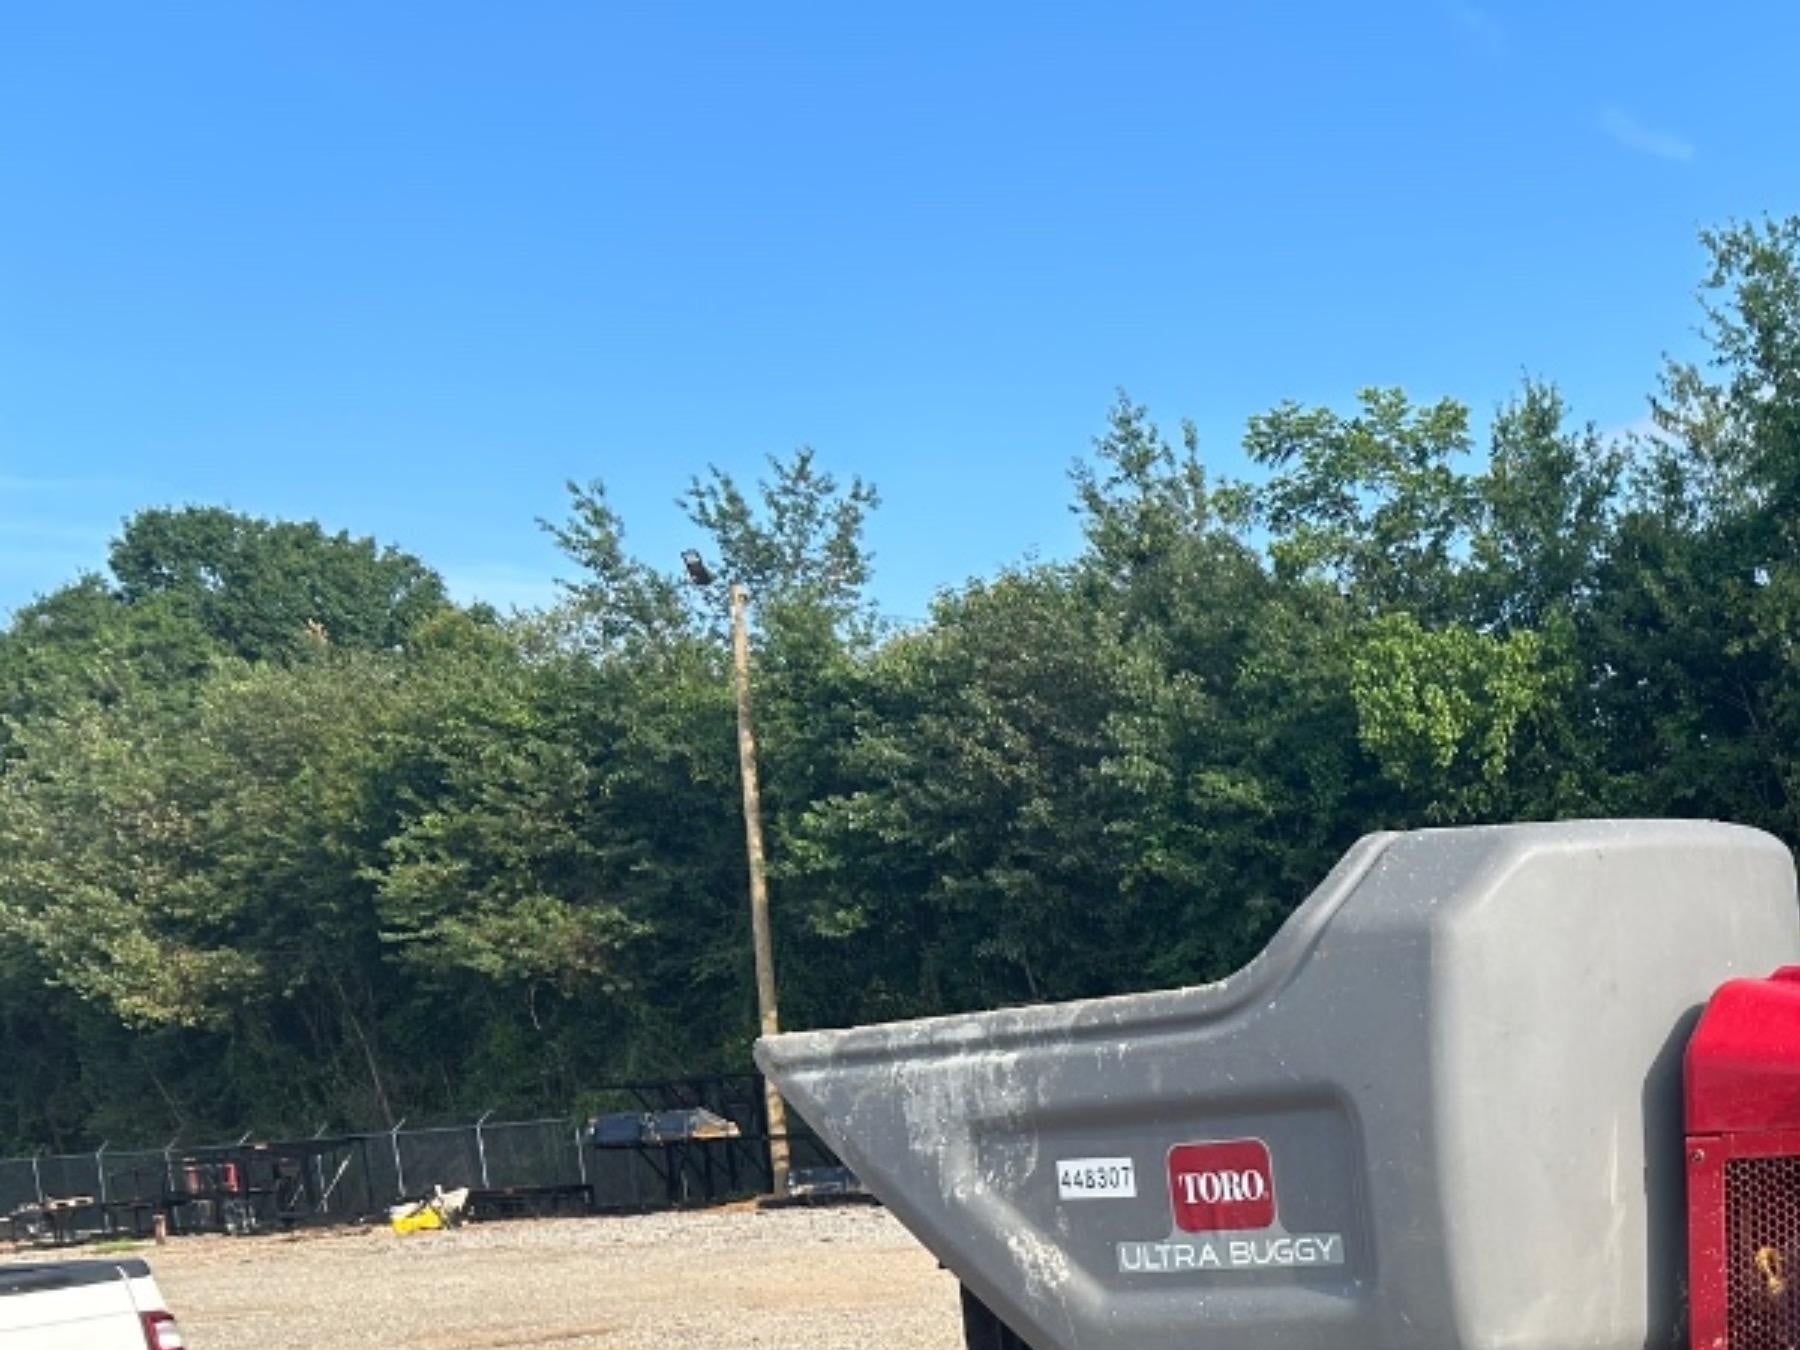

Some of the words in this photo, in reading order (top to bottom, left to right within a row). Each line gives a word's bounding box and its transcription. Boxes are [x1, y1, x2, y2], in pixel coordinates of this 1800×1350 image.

[1178, 1169, 1265, 1205] TORO
[1120, 1243, 1219, 1270] ULTRA
[1230, 1238, 1335, 1265] BUGGY
